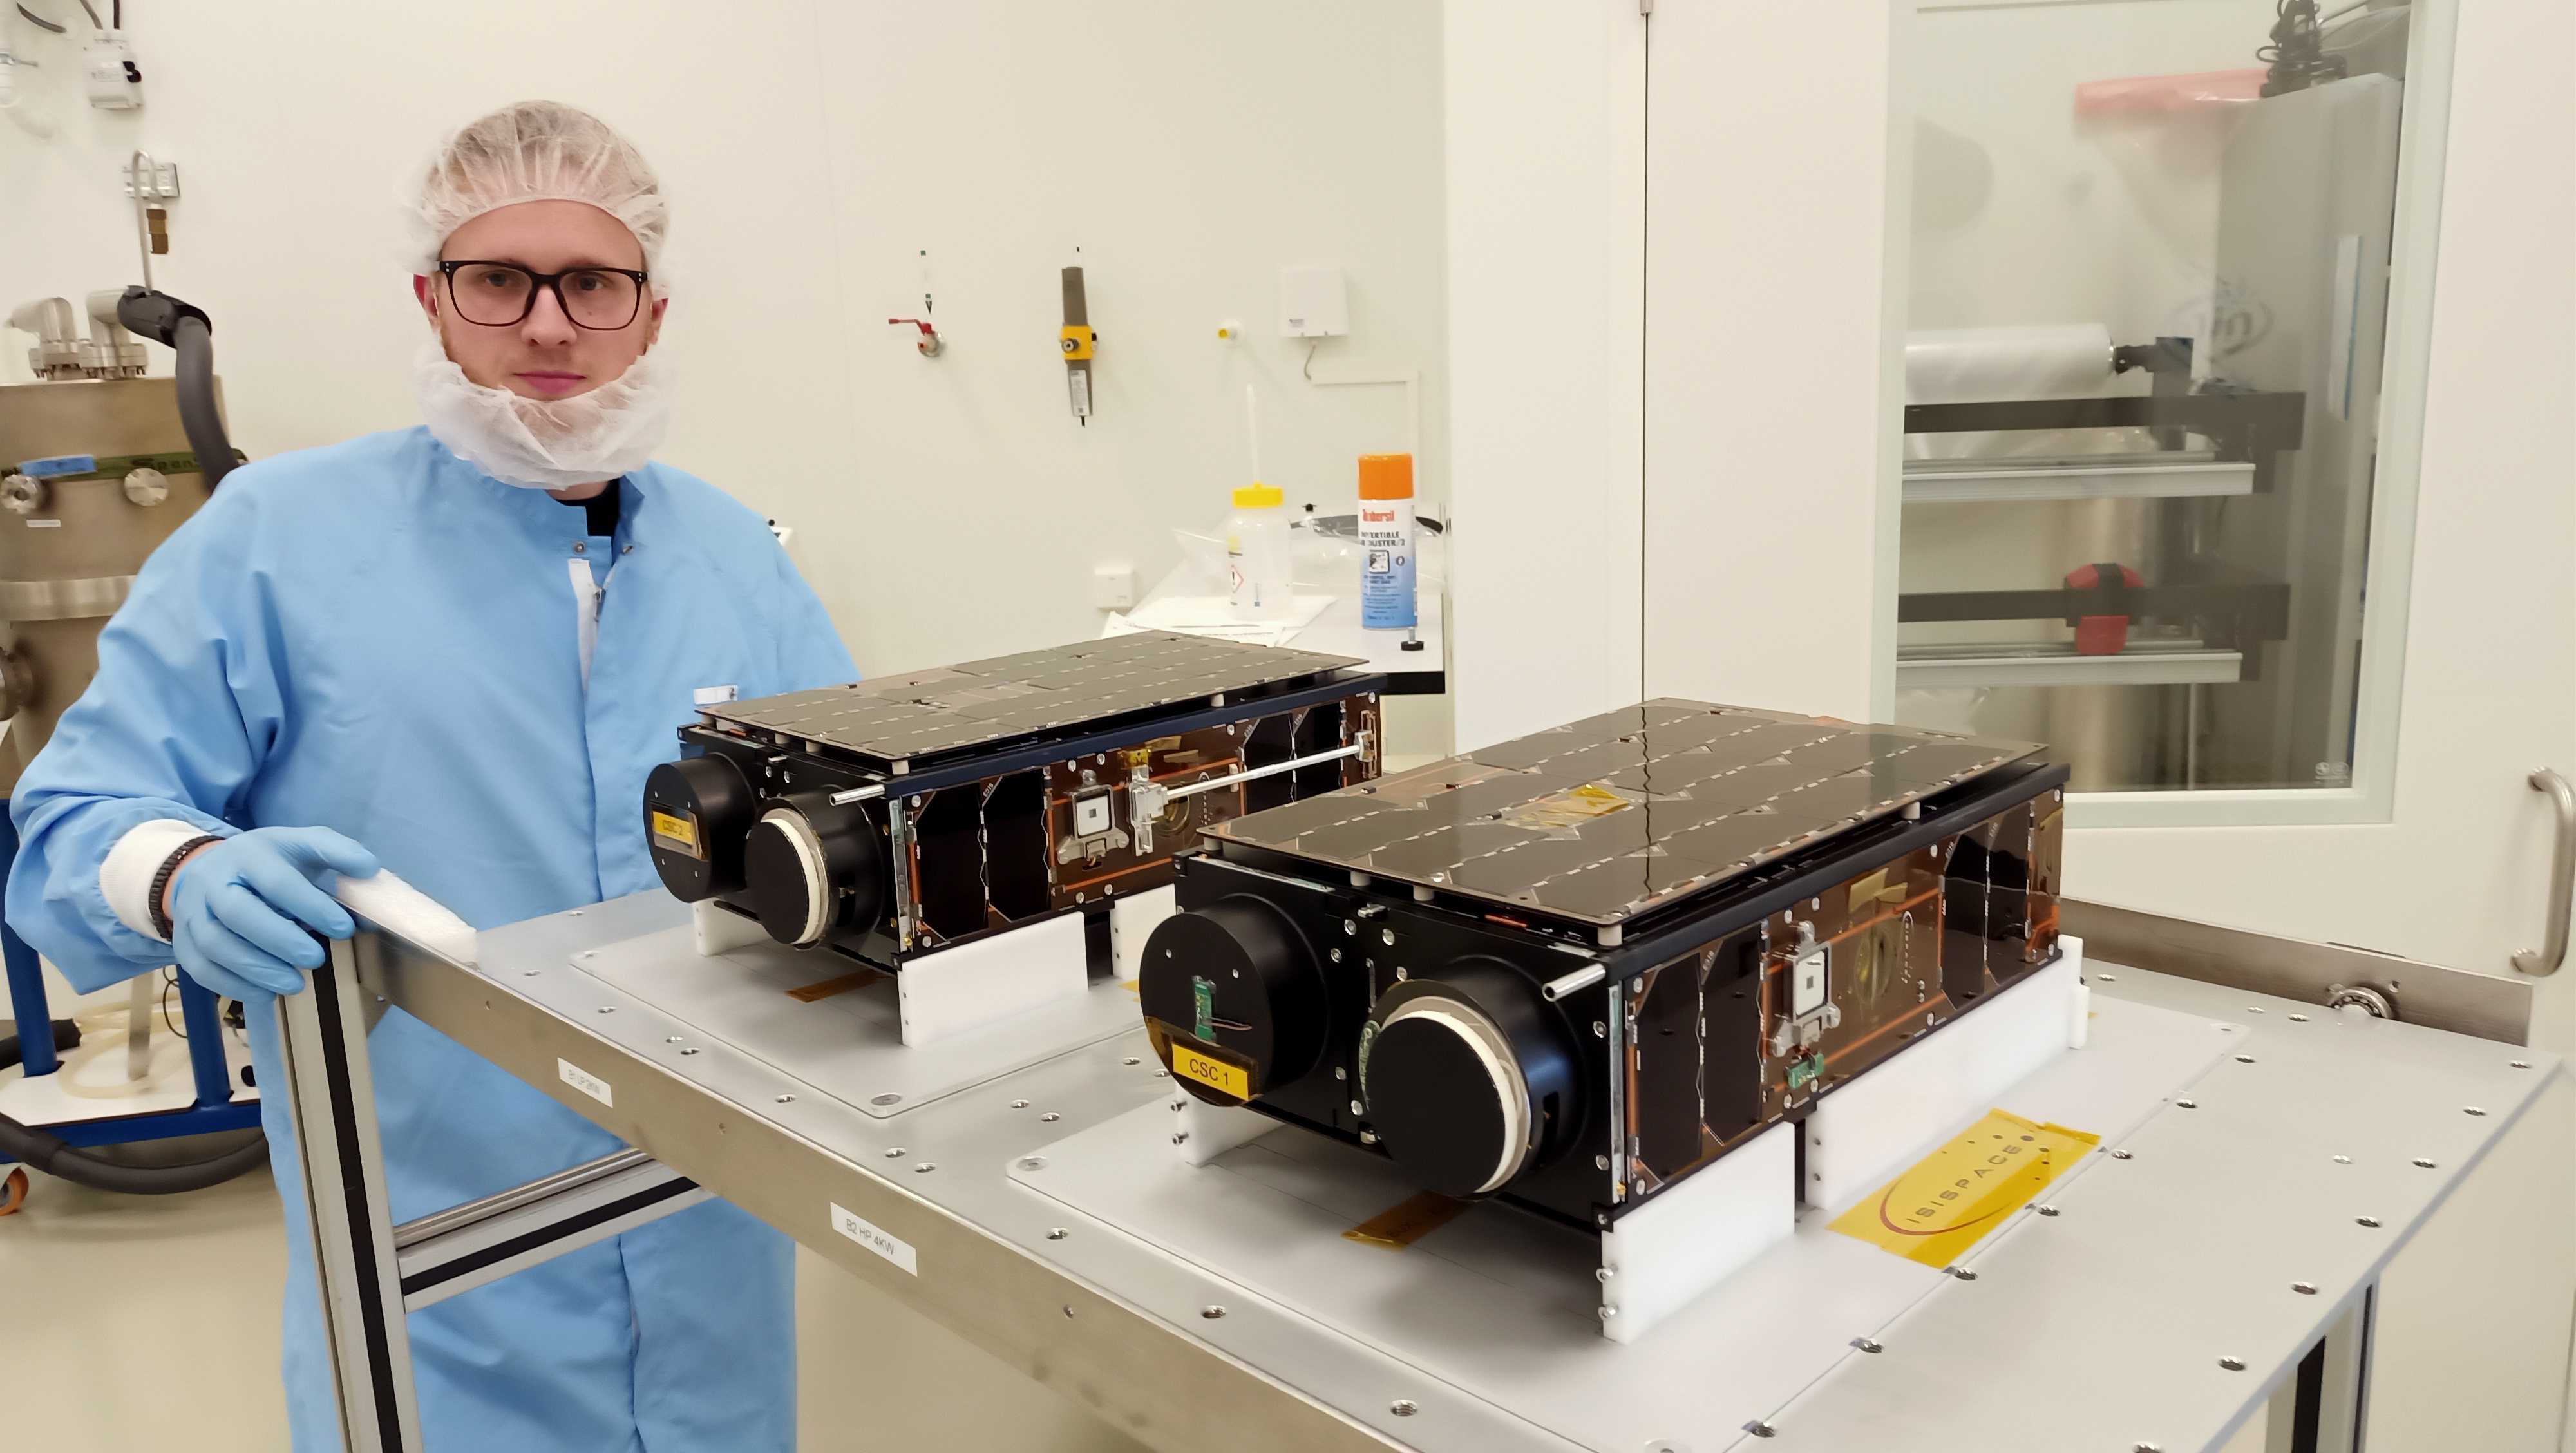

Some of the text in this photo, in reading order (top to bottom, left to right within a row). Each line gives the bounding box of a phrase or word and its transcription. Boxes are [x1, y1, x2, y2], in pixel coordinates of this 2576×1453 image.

[662, 819, 678, 833] CSC
[1189, 1058, 1229, 1087] CSC 1
[1906, 1144, 2022, 1224] ISISPACE
[846, 1218, 895, 1256] B2 HP 4KW
